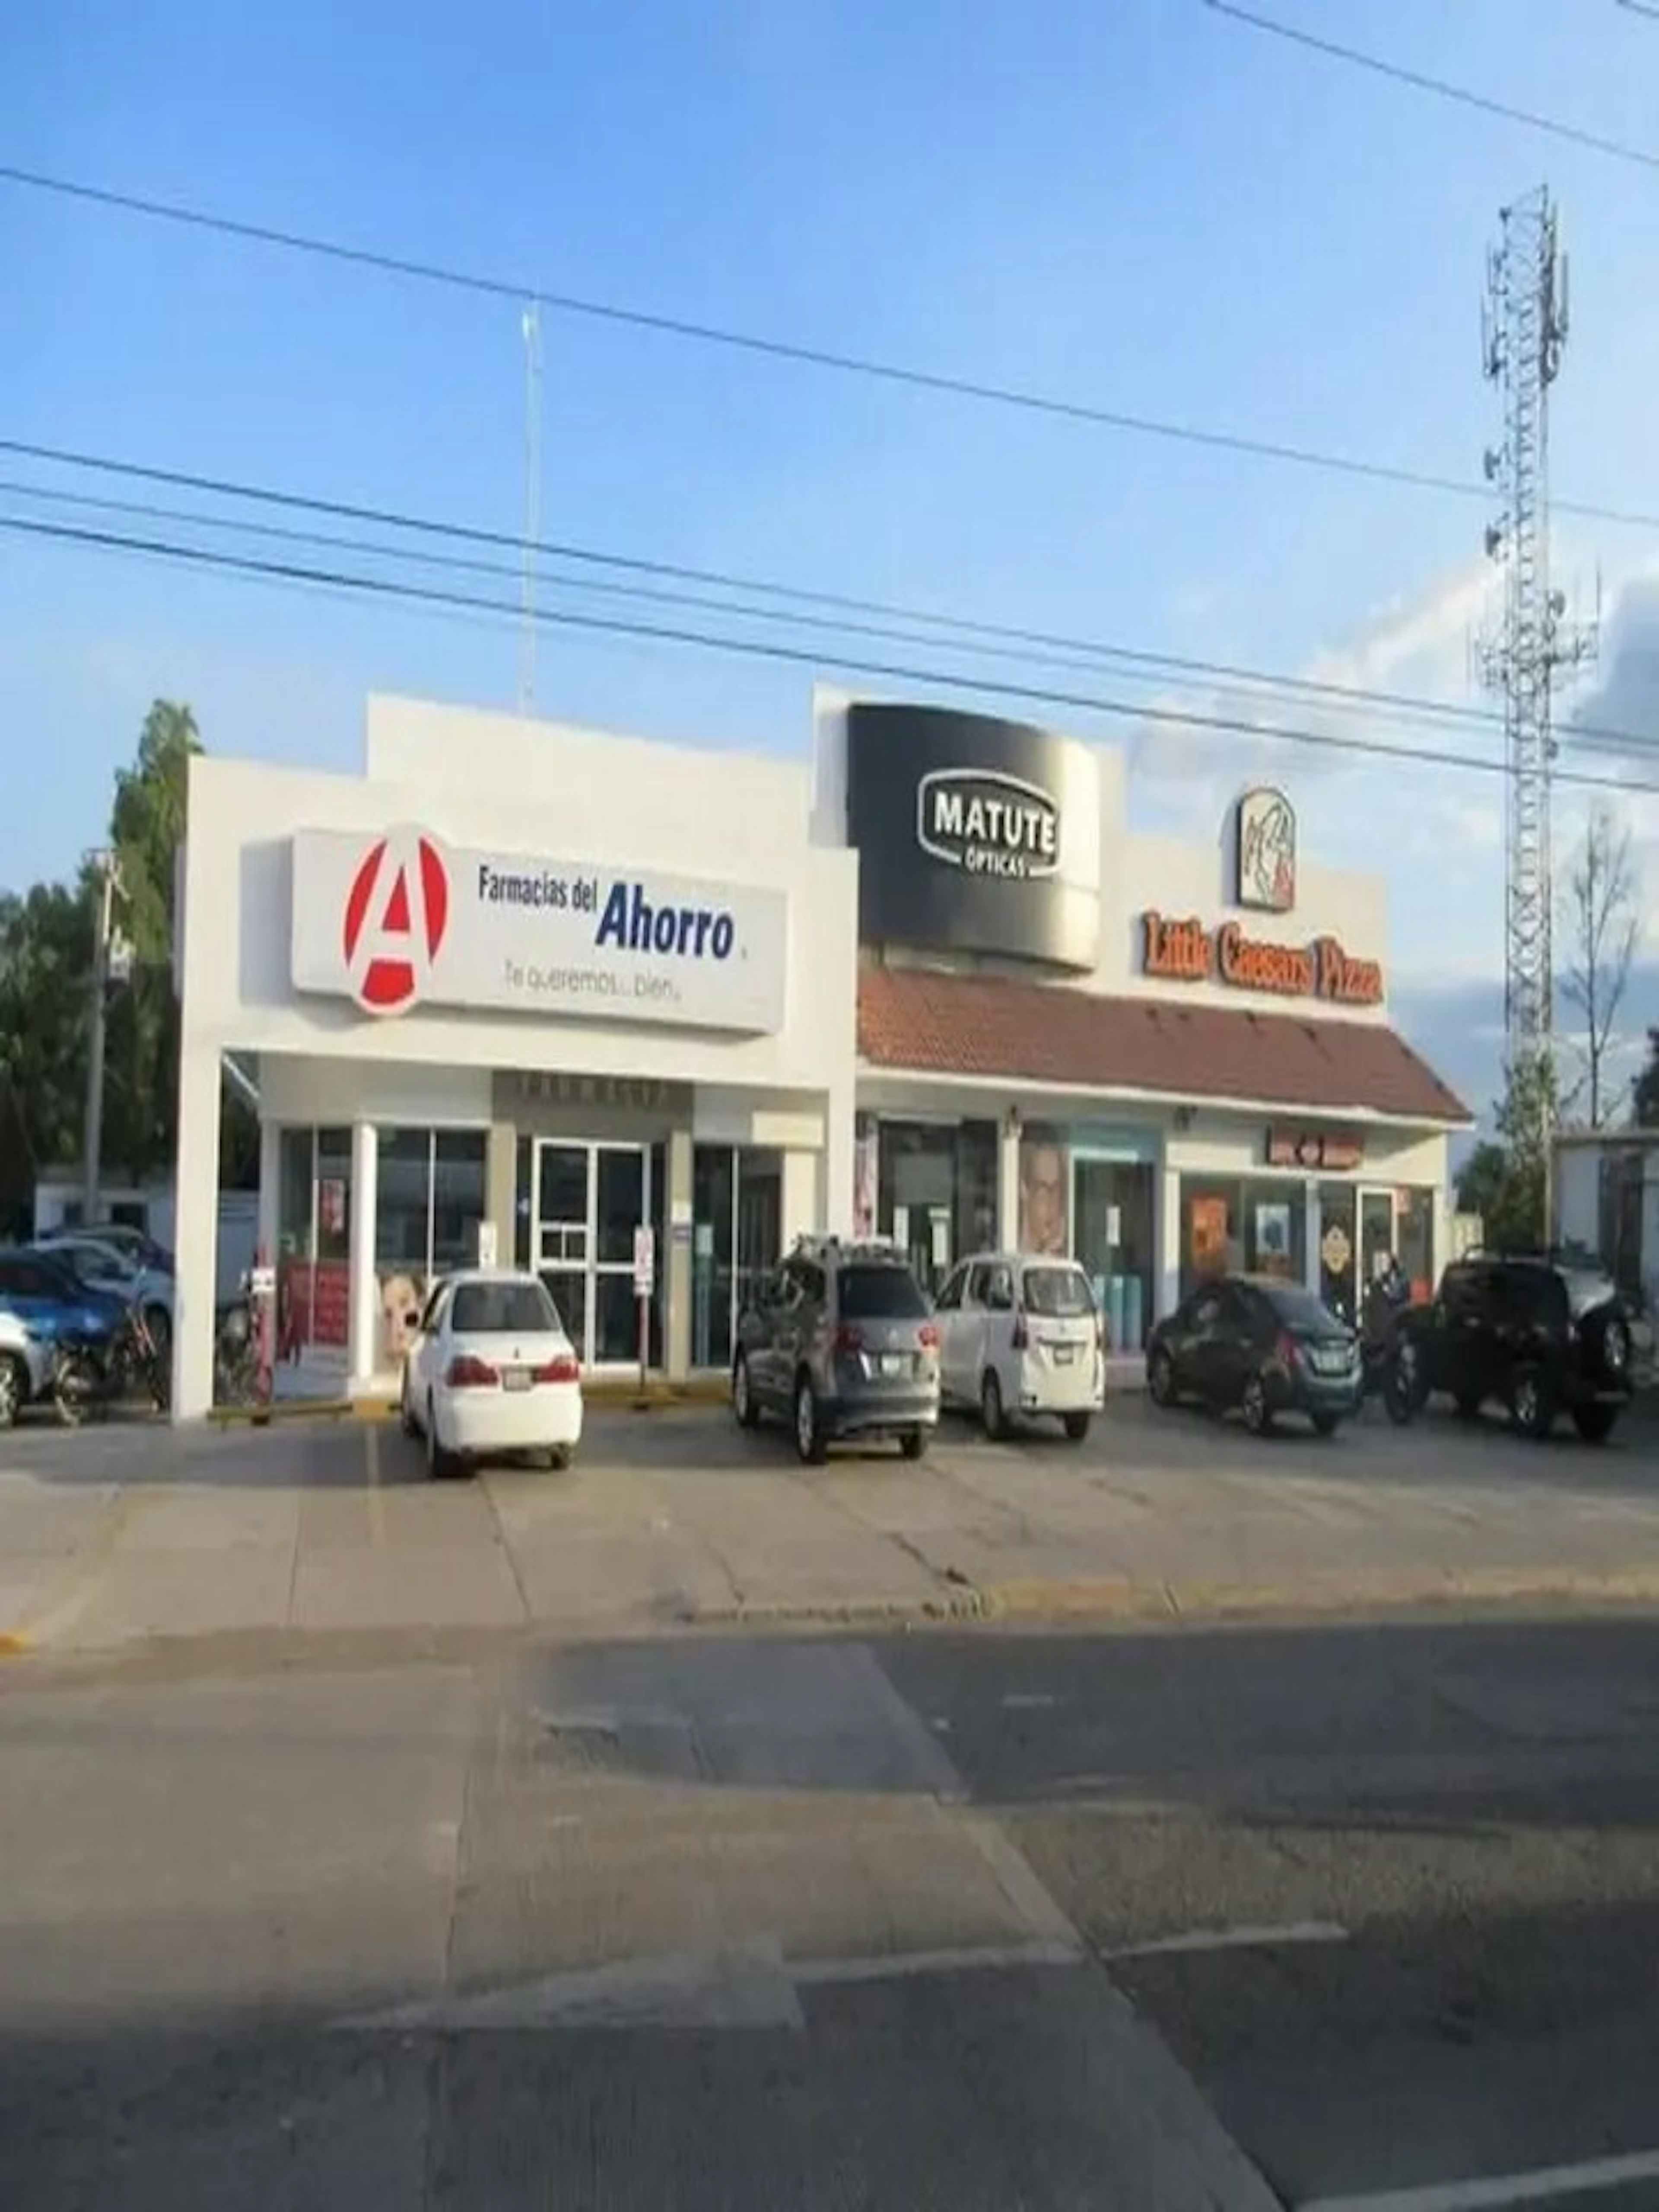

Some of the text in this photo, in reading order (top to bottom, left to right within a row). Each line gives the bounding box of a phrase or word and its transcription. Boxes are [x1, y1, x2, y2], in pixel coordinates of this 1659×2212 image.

[934, 790, 1056, 854] MATUTE
[478, 865, 597, 912] Farmacias del
[594, 879, 734, 960] Ahorro
